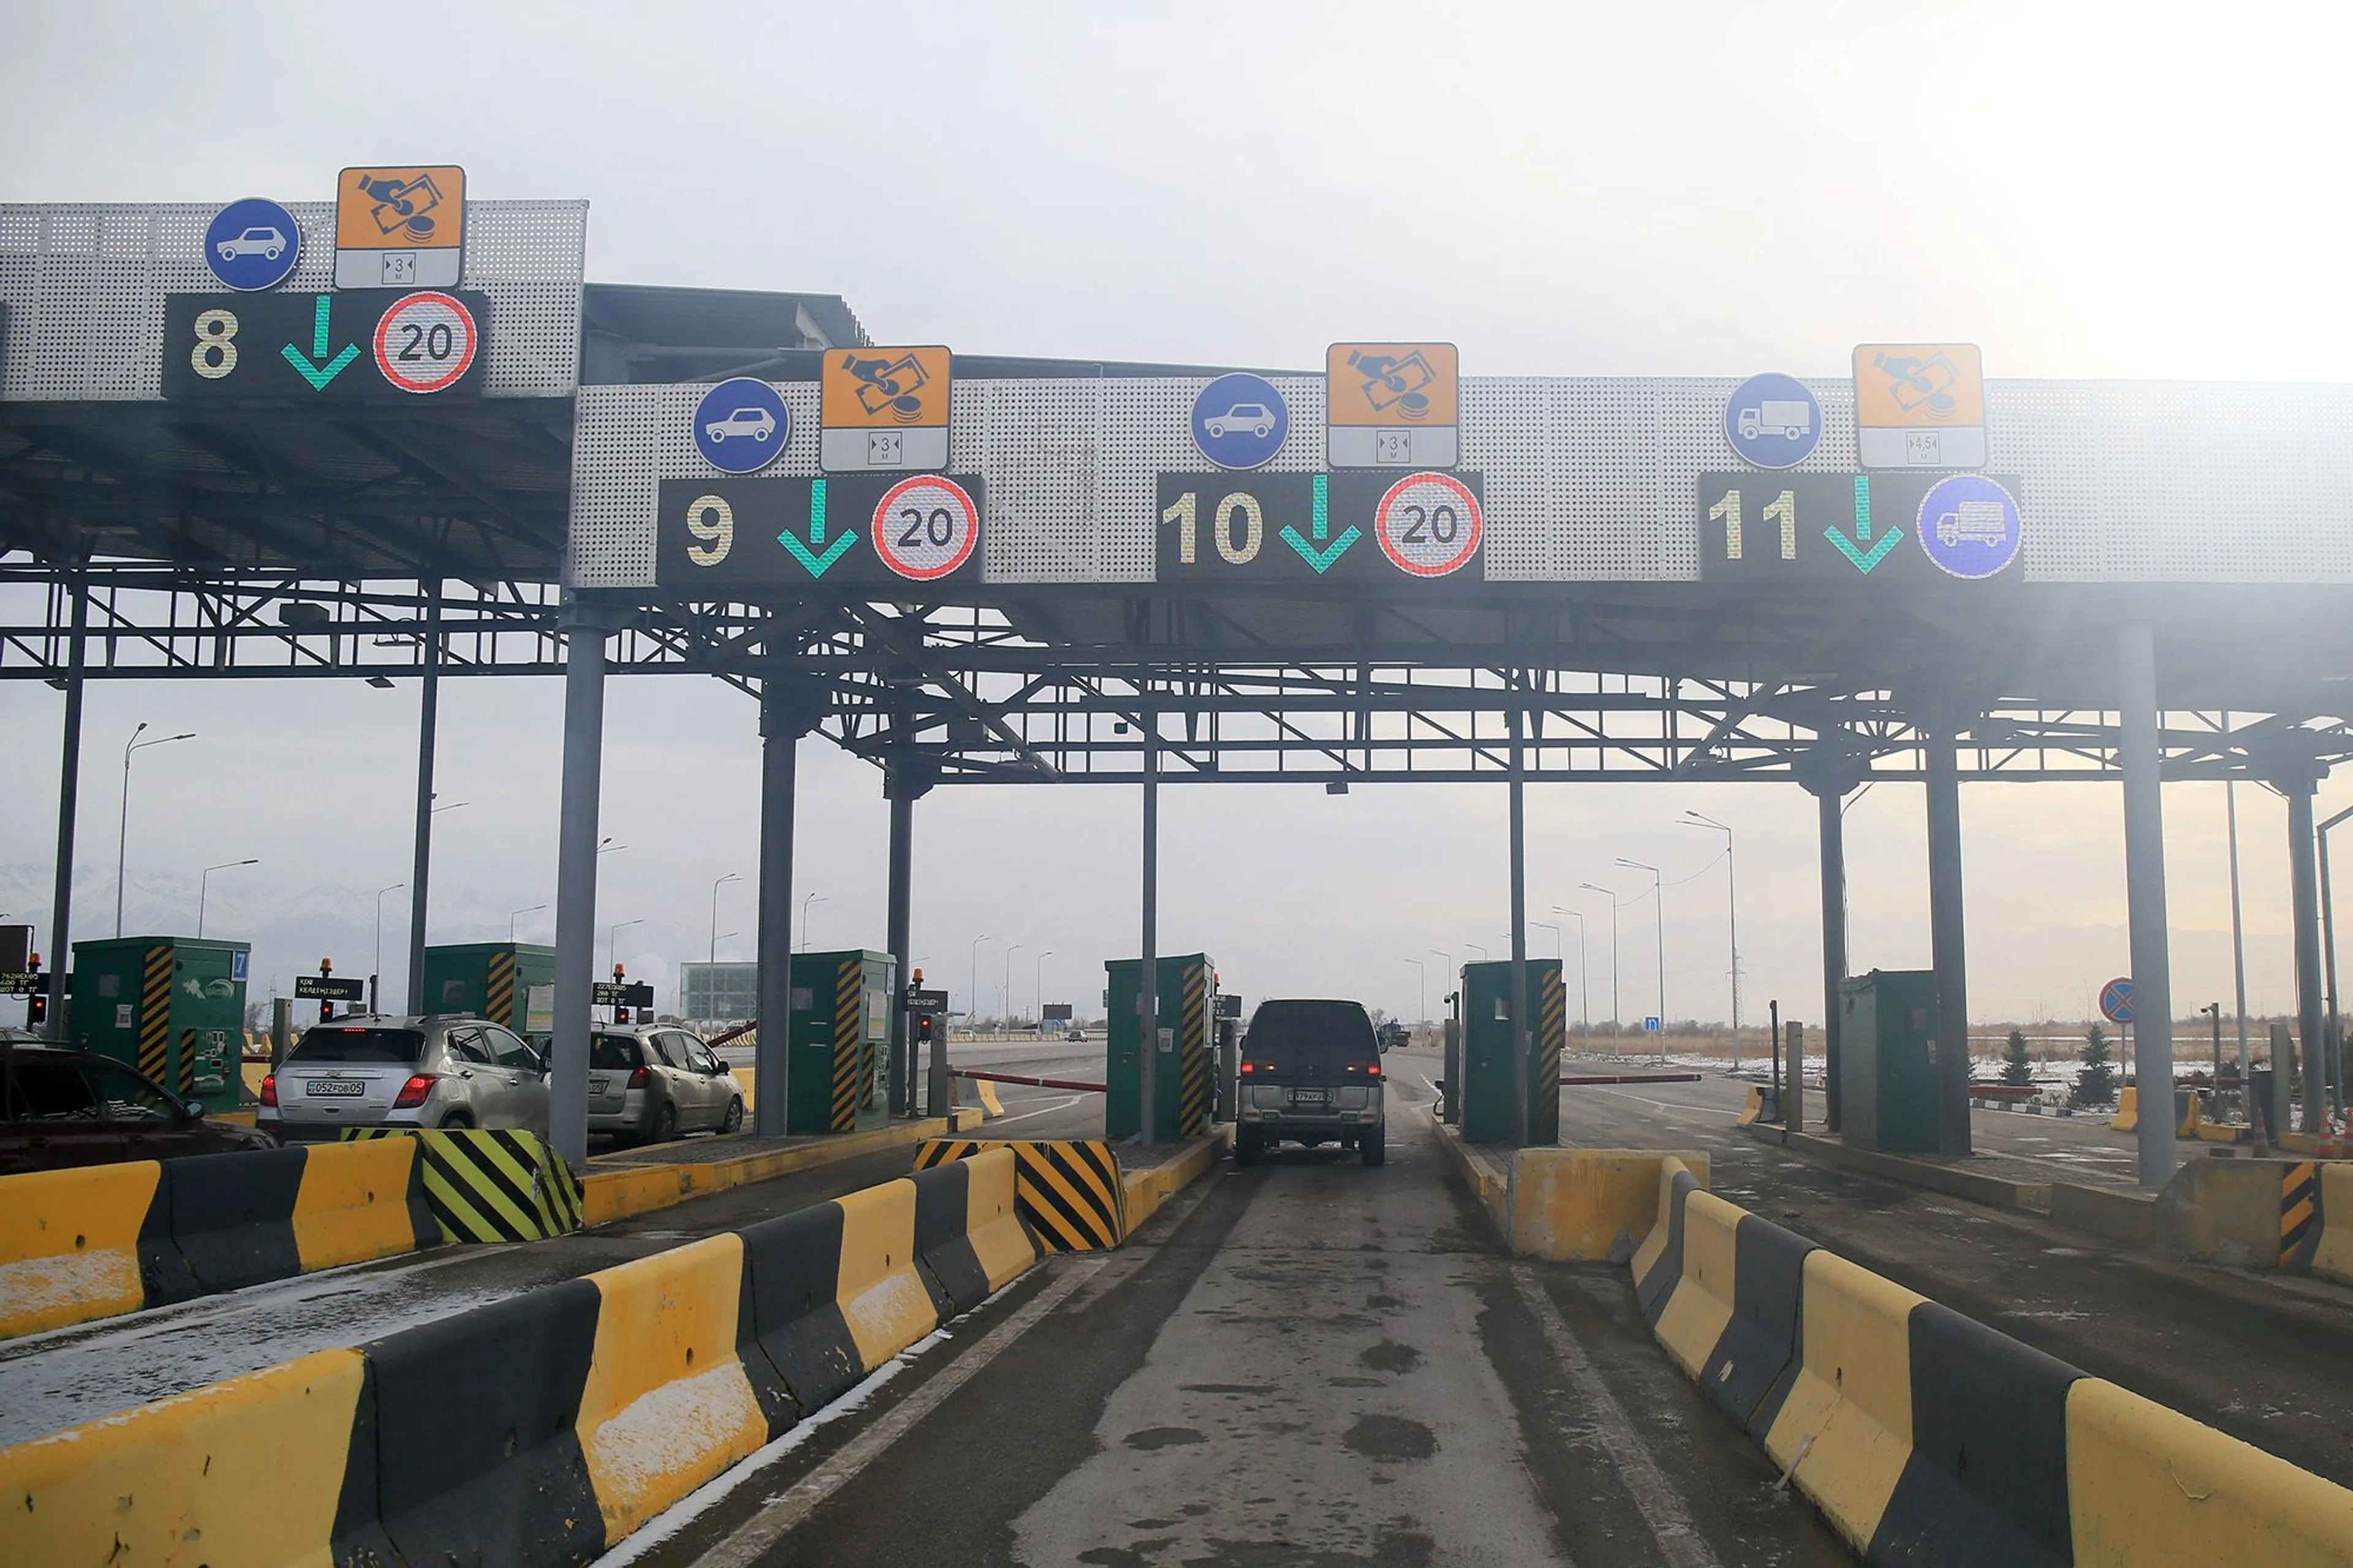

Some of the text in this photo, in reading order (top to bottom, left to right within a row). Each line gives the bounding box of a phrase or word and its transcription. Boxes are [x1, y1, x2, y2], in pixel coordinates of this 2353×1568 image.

[395, 259, 403, 272] 3
[191, 309, 240, 380] 8
[398, 323, 453, 361] 20
[881, 437, 890, 452] 3
[1389, 436, 1398, 450] 3
[687, 494, 734, 567] 9
[897, 508, 953, 547] 20
[1162, 492, 1264, 565] 10
[1401, 505, 1458, 543] 20
[1708, 490, 1797, 560] 11
[235, 953, 246, 973] 7
